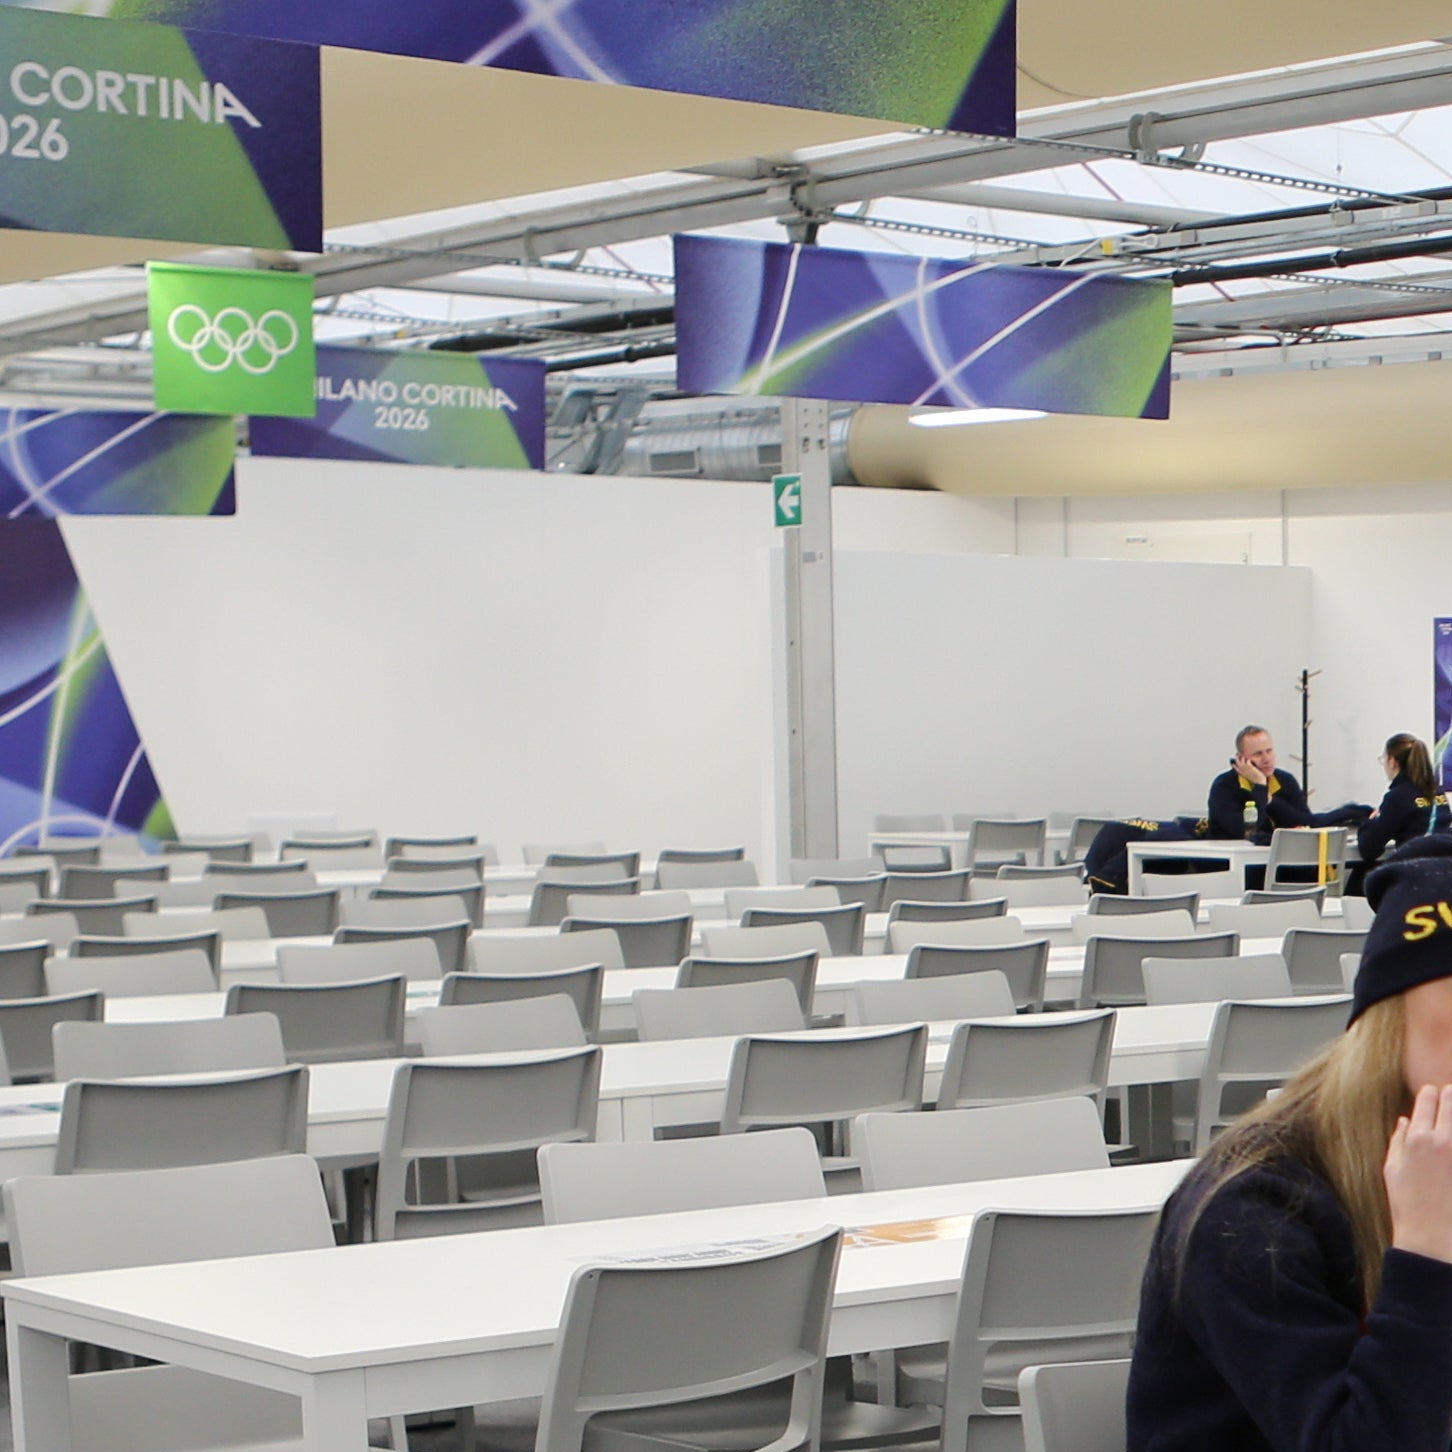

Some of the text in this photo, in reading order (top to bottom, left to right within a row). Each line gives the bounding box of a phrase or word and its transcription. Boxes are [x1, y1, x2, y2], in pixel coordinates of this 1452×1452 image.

[10, 61, 262, 128] CORTINA
[314, 376, 518, 411] ILANO CORTINA
[374, 406, 430, 430] 2026
